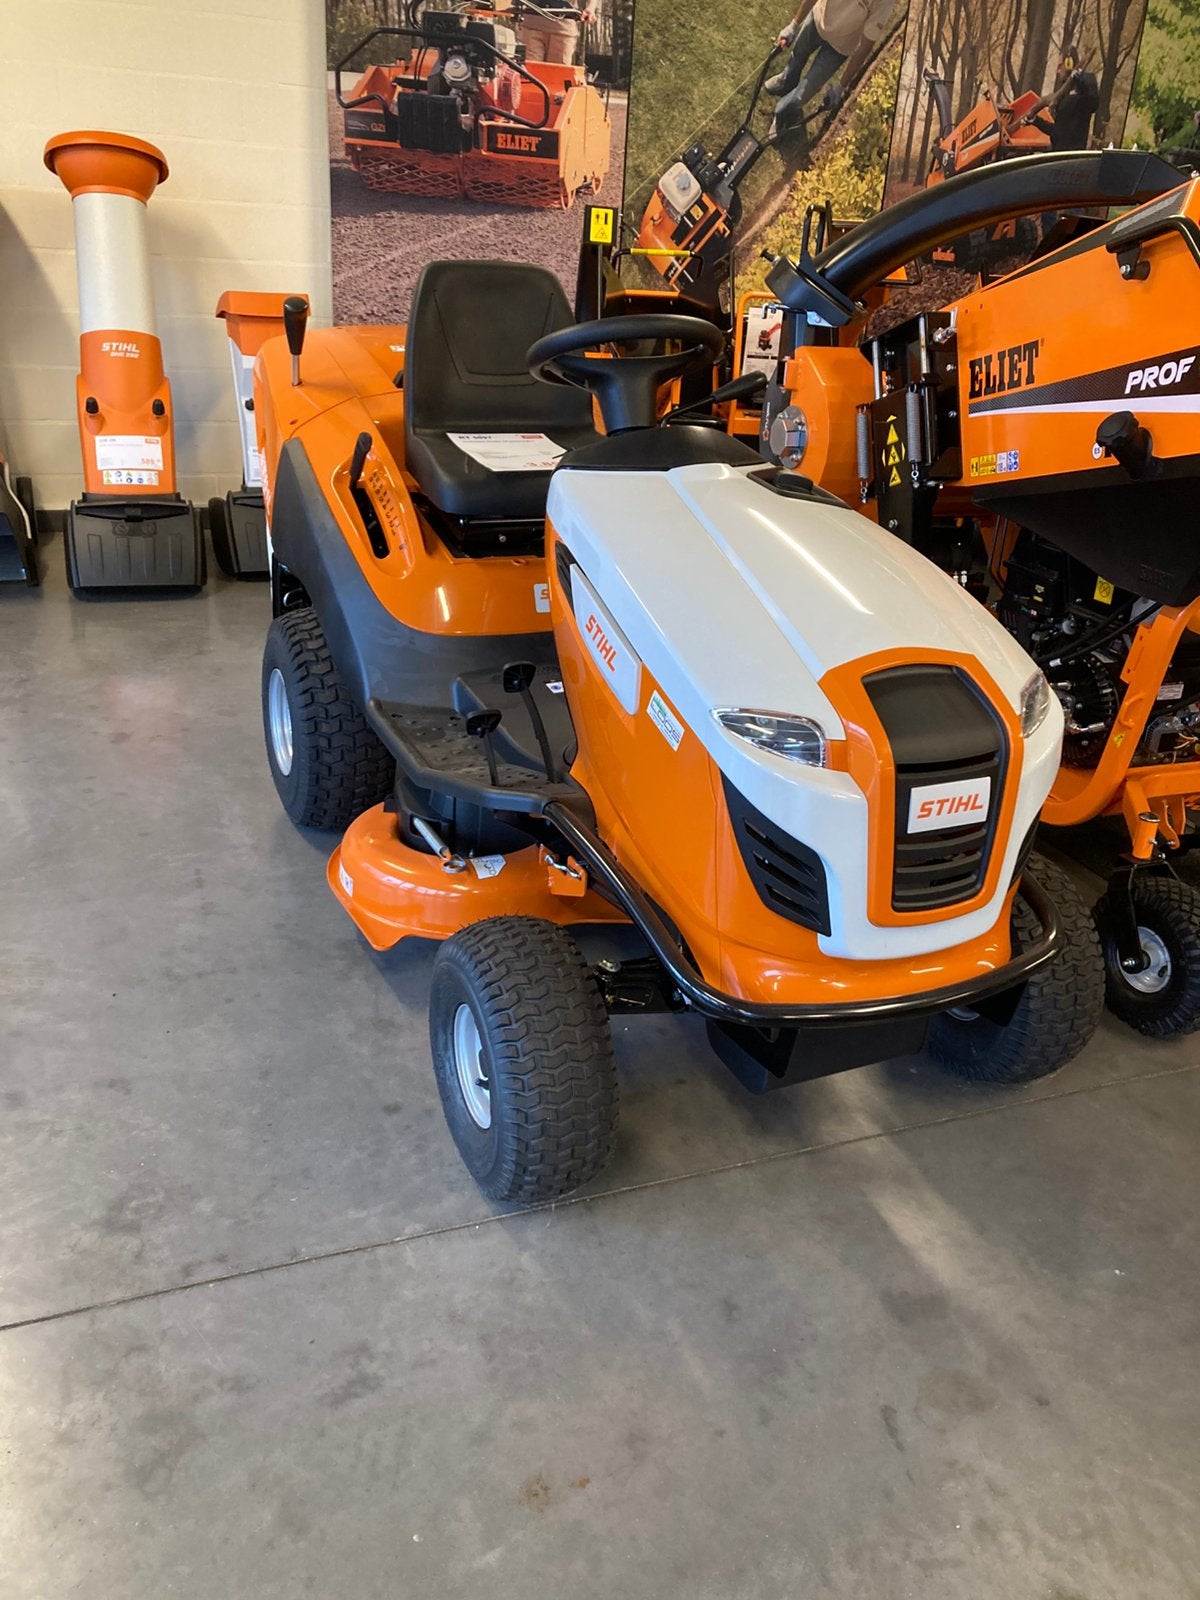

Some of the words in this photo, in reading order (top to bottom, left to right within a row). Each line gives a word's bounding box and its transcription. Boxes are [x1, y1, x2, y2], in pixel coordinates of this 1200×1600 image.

[496, 134, 539, 152] ELIET
[101, 342, 140, 353] STIHL
[968, 339, 1039, 399] ELIET
[1124, 355, 1196, 395] PROF
[585, 614, 617, 673] STIHL
[916, 793, 984, 820] STIHL
